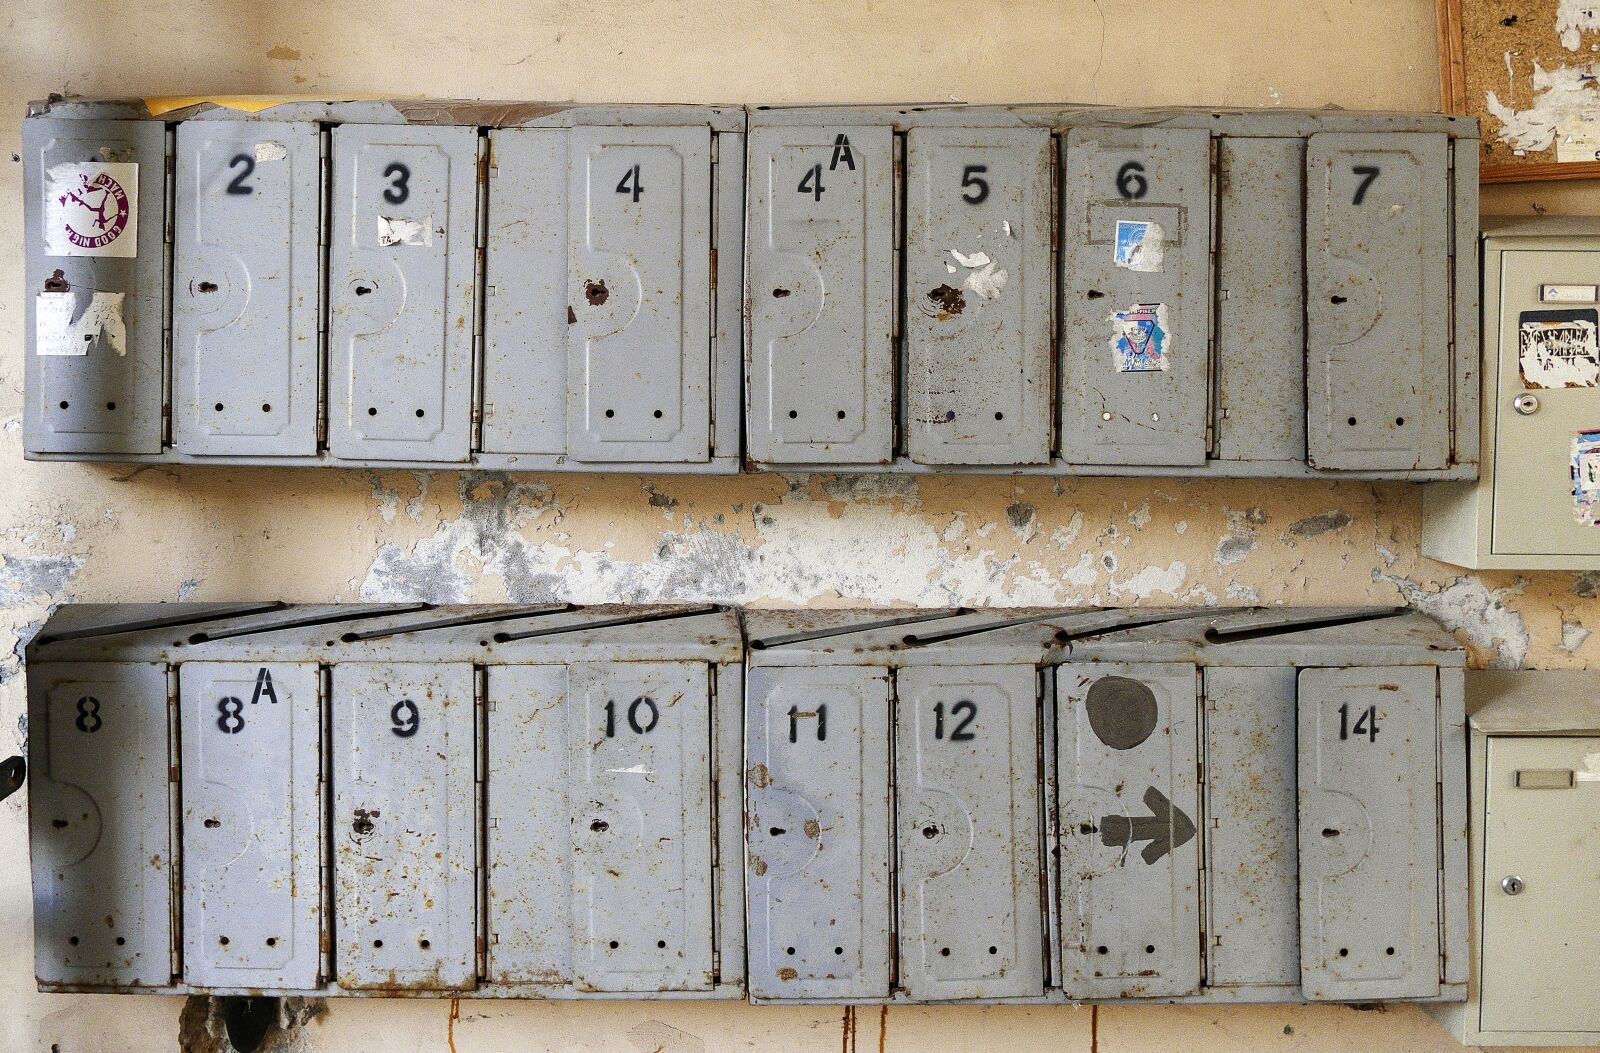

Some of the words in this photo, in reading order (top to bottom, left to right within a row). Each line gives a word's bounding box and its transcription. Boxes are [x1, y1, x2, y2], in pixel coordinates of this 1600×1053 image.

[226, 153, 256, 196] 2
[382, 161, 411, 206] 3
[615, 164, 645, 203] 4
[961, 164, 991, 206] 5
[1115, 160, 1148, 202] 6
[1351, 165, 1381, 206] 7
[94, 225, 122, 247] GOOD
[75, 696, 103, 734] 8
[390, 698, 420, 739] 9
[604, 696, 660, 739] 10
[787, 703, 827, 744] 11
[932, 699, 978, 743] 12
[1337, 703, 1380, 743] 14
